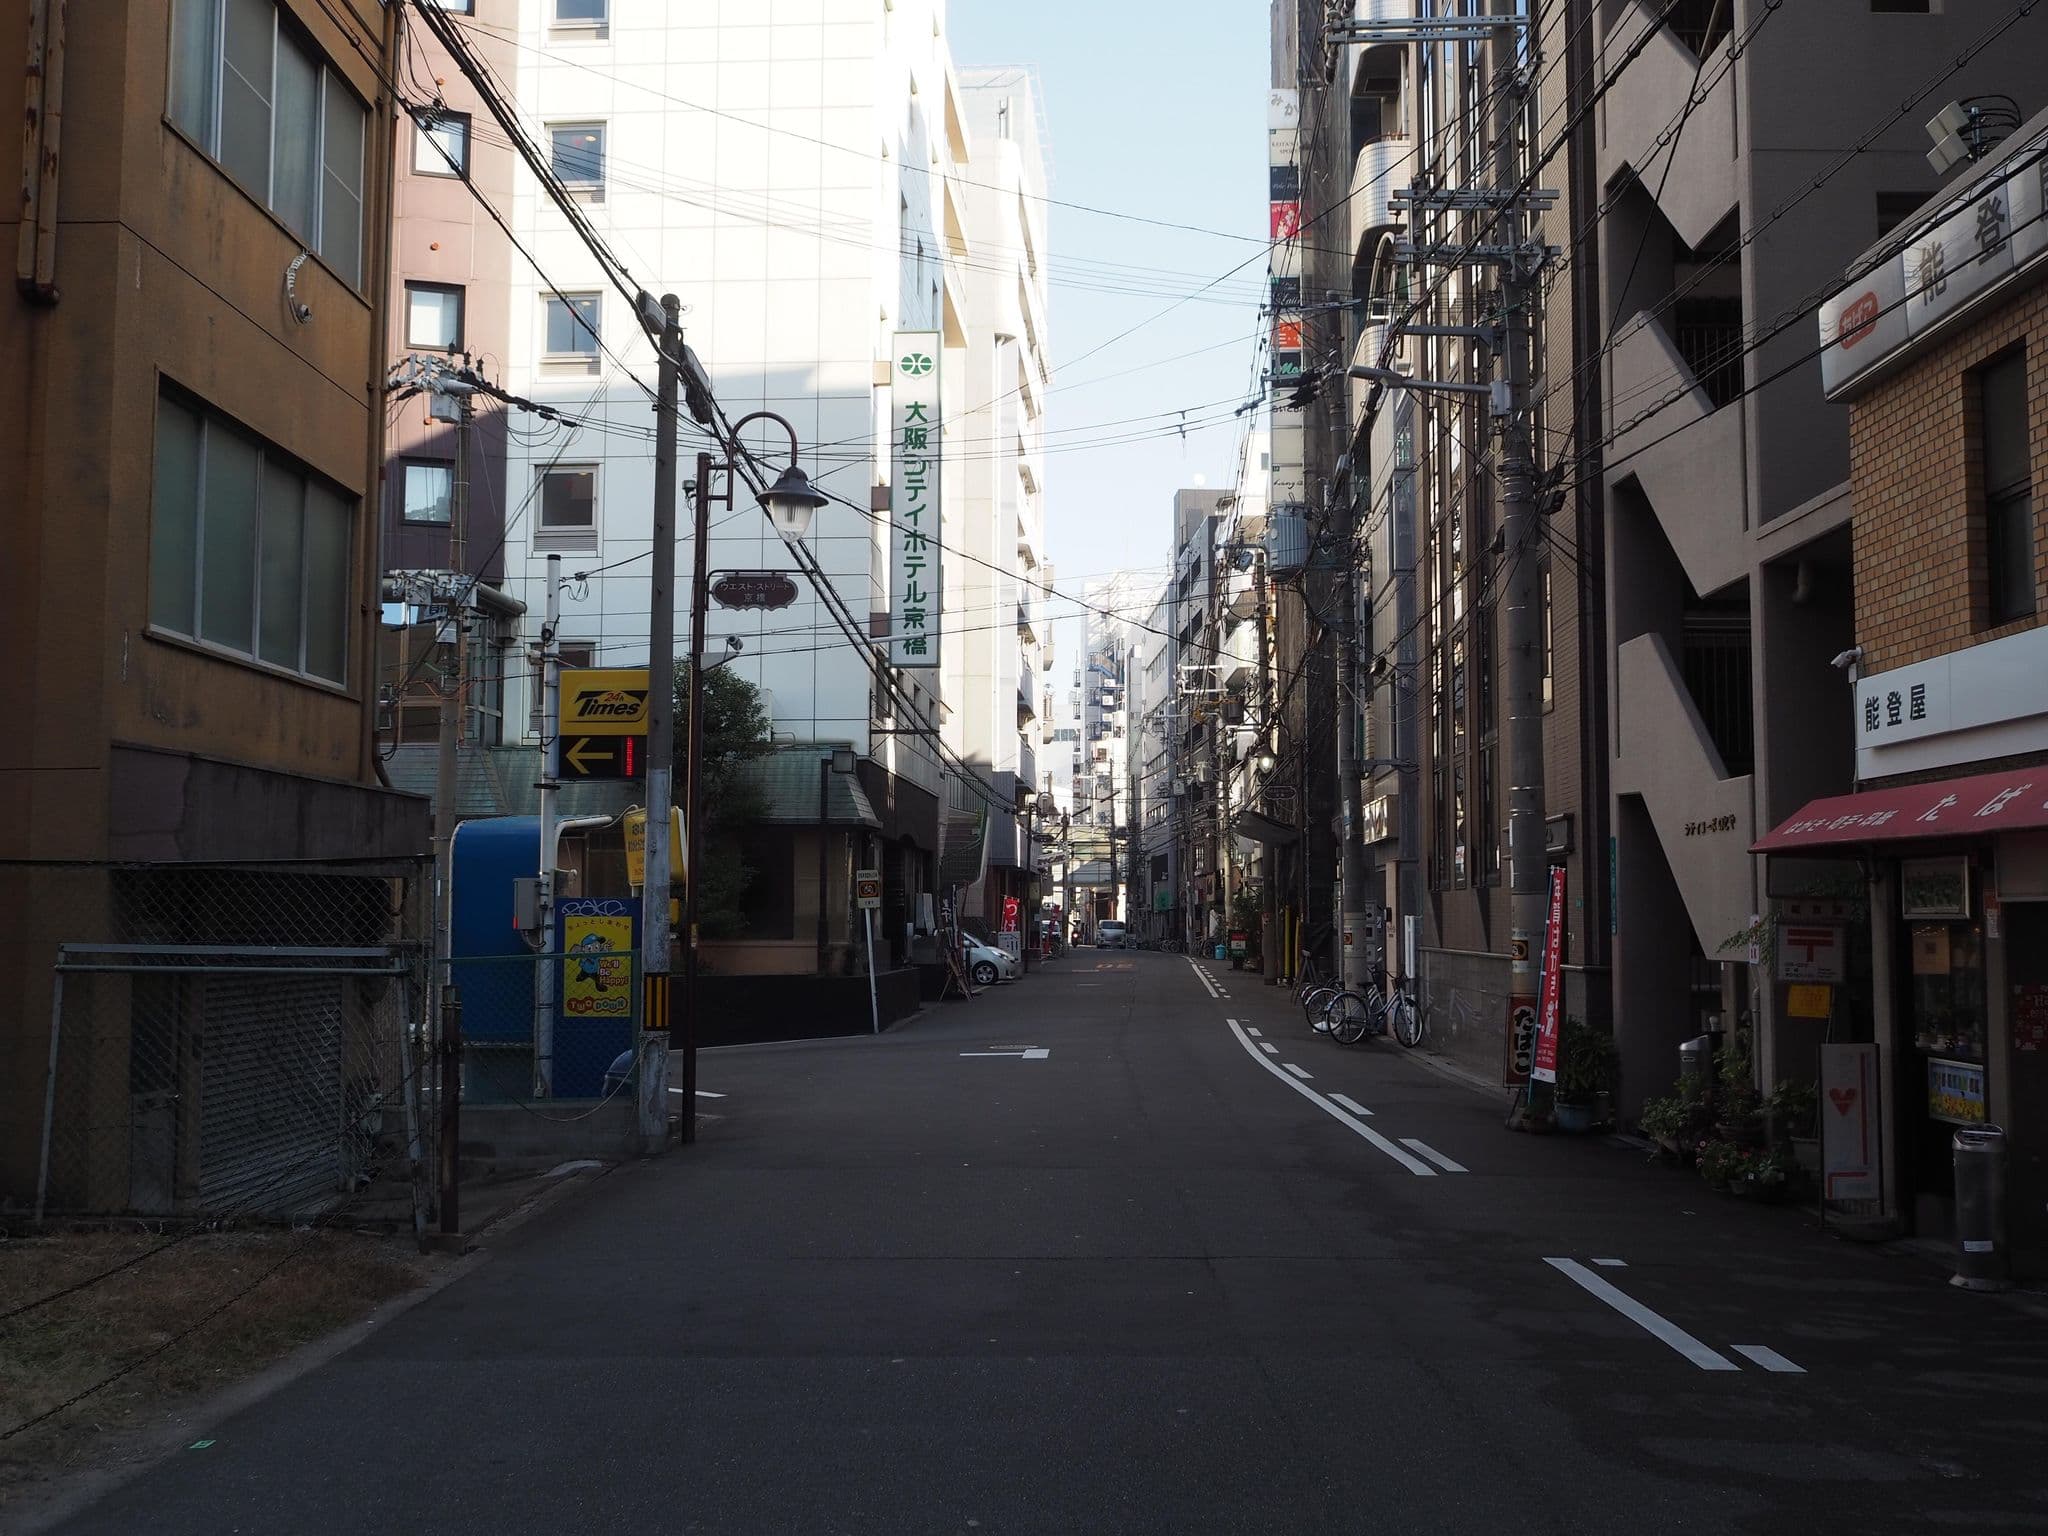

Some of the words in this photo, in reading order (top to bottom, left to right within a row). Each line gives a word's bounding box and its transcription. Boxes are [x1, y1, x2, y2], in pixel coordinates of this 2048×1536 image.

[1919, 156, 2048, 306] 能登
[902, 401, 928, 655] 大阪シティホテル京橋
[577, 692, 641, 717] Times
[1865, 683, 1926, 732] 能登屋
[1916, 783, 2048, 822] たば
[600, 975, 628, 986] Happy!
[567, 998, 593, 1012] TWO
[595, 998, 627, 1011] DOWN
[1514, 1008, 1534, 1073] たばこ
